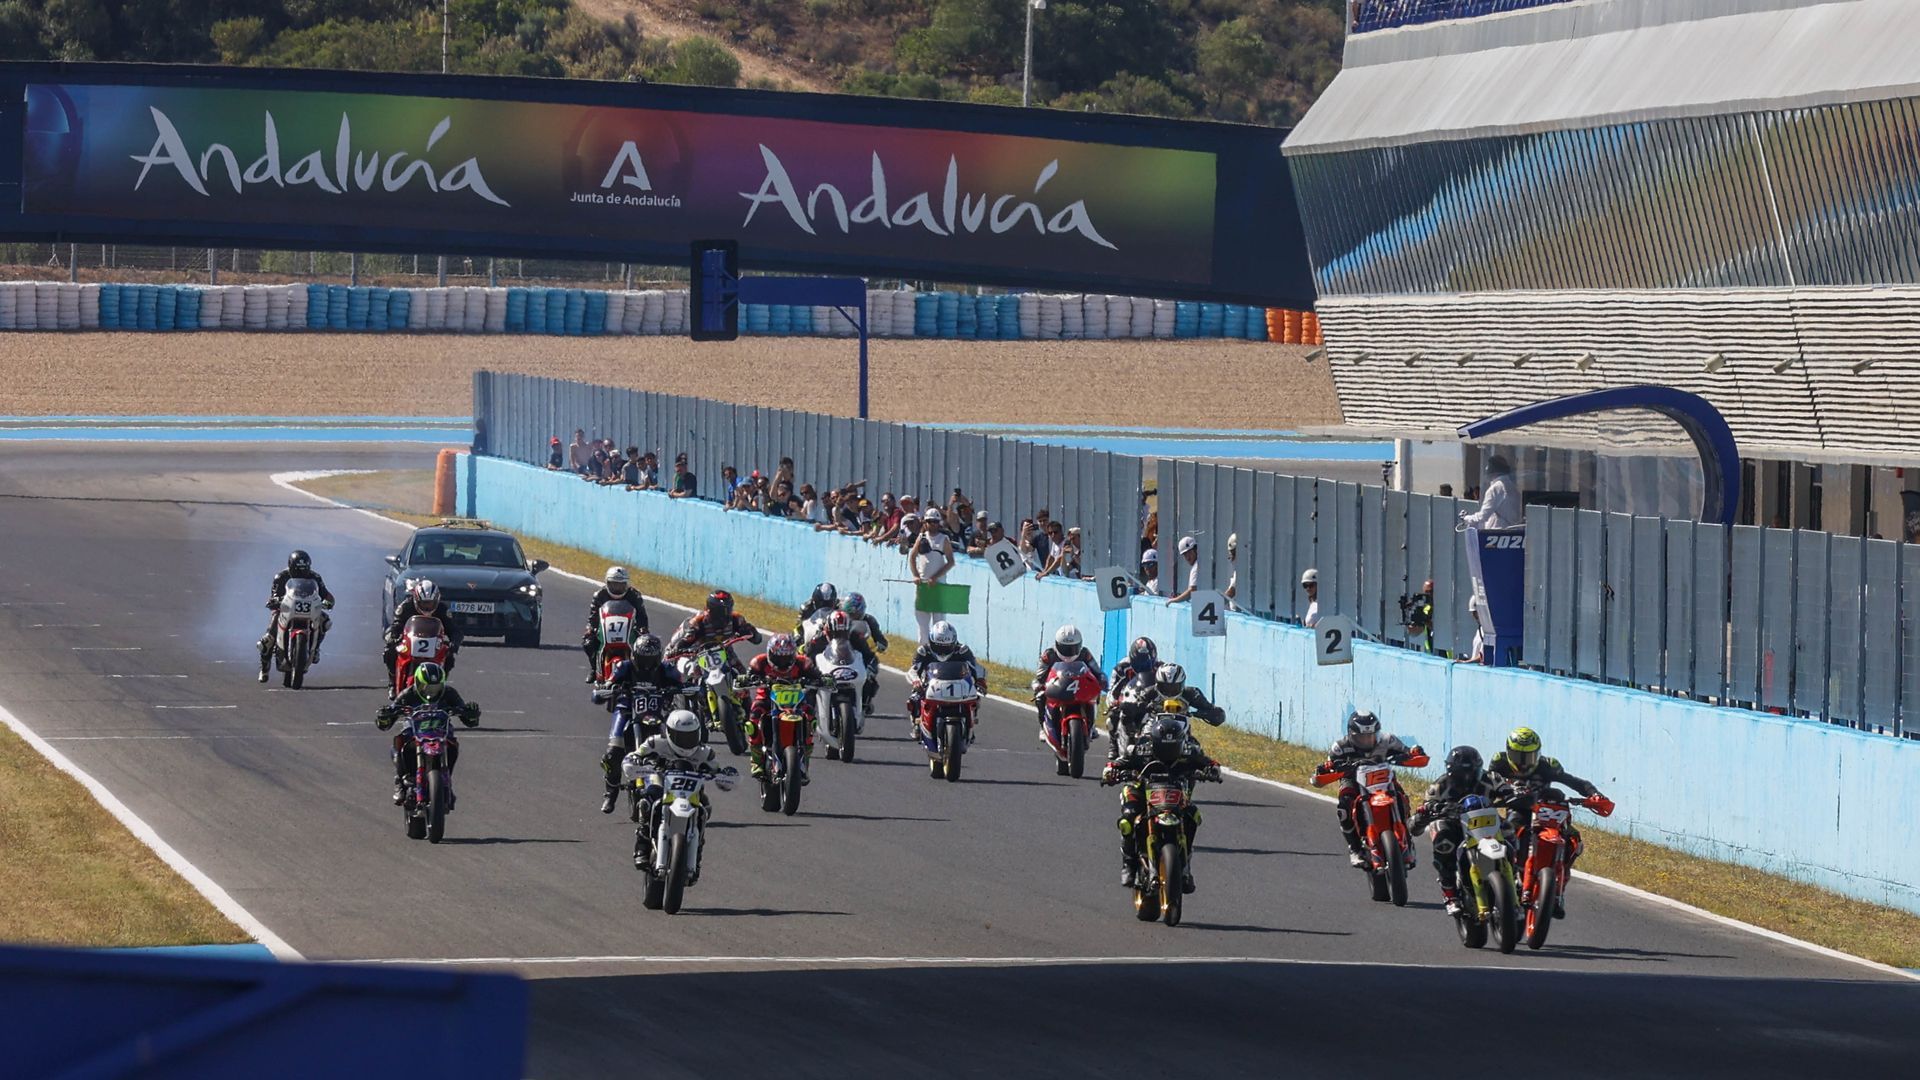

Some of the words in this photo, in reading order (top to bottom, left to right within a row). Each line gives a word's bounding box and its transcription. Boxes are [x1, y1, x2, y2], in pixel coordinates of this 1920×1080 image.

[129, 106, 511, 207] Andalucía
[571, 192, 604, 204] Junta
[606, 194, 622, 204] de
[624, 195, 681, 208] Andalucía
[738, 143, 1119, 250] Andalucía
[1484, 535, 1526, 549] 202
[996, 551, 1014, 571] 8
[1111, 576, 1128, 599] 6
[295, 601, 311, 613] 33
[1198, 602, 1218, 625] 4
[609, 621, 625, 633] 17
[418, 640, 429, 653] 2
[1325, 629, 1343, 655] 2
[946, 684, 954, 697] 1
[1066, 680, 1079, 695] 4
[776, 691, 800, 704] 101
[671, 777, 698, 792] 28
[1365, 769, 1389, 787] 12
[1537, 807, 1569, 824] 24
